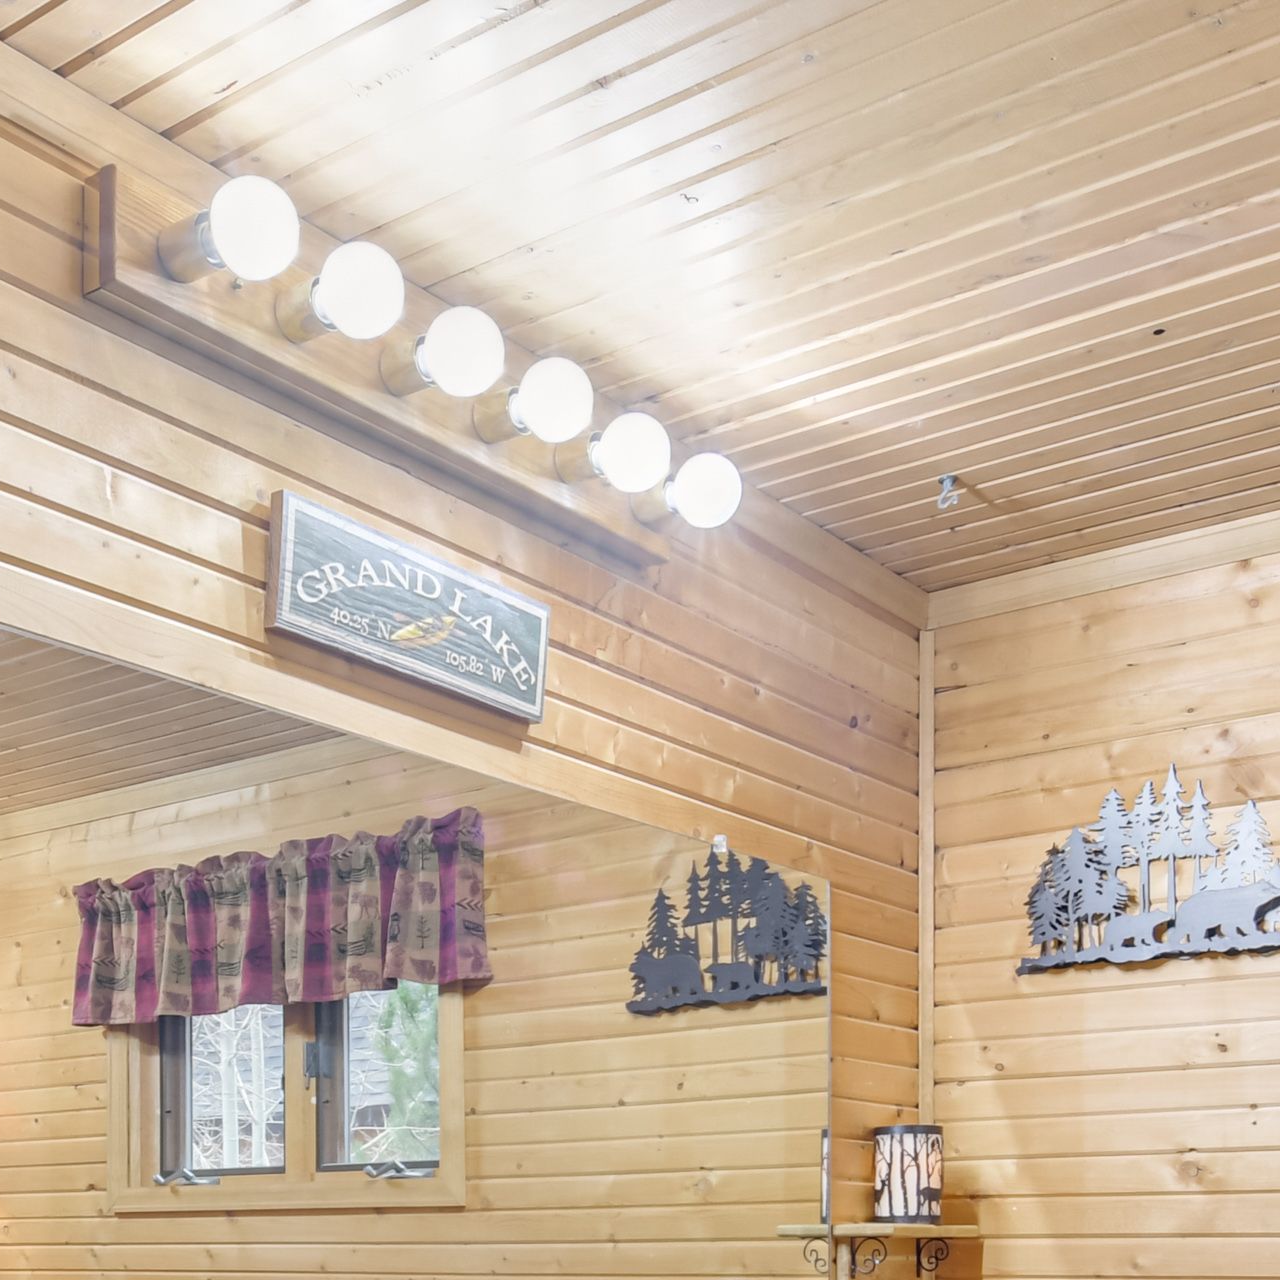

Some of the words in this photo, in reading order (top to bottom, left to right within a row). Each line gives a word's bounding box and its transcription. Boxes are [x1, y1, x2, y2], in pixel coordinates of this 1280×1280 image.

[296, 558, 442, 603] GRAND
[448, 587, 536, 691] LAKE
[377, 620, 392, 640] N
[490, 664, 508, 684] W
